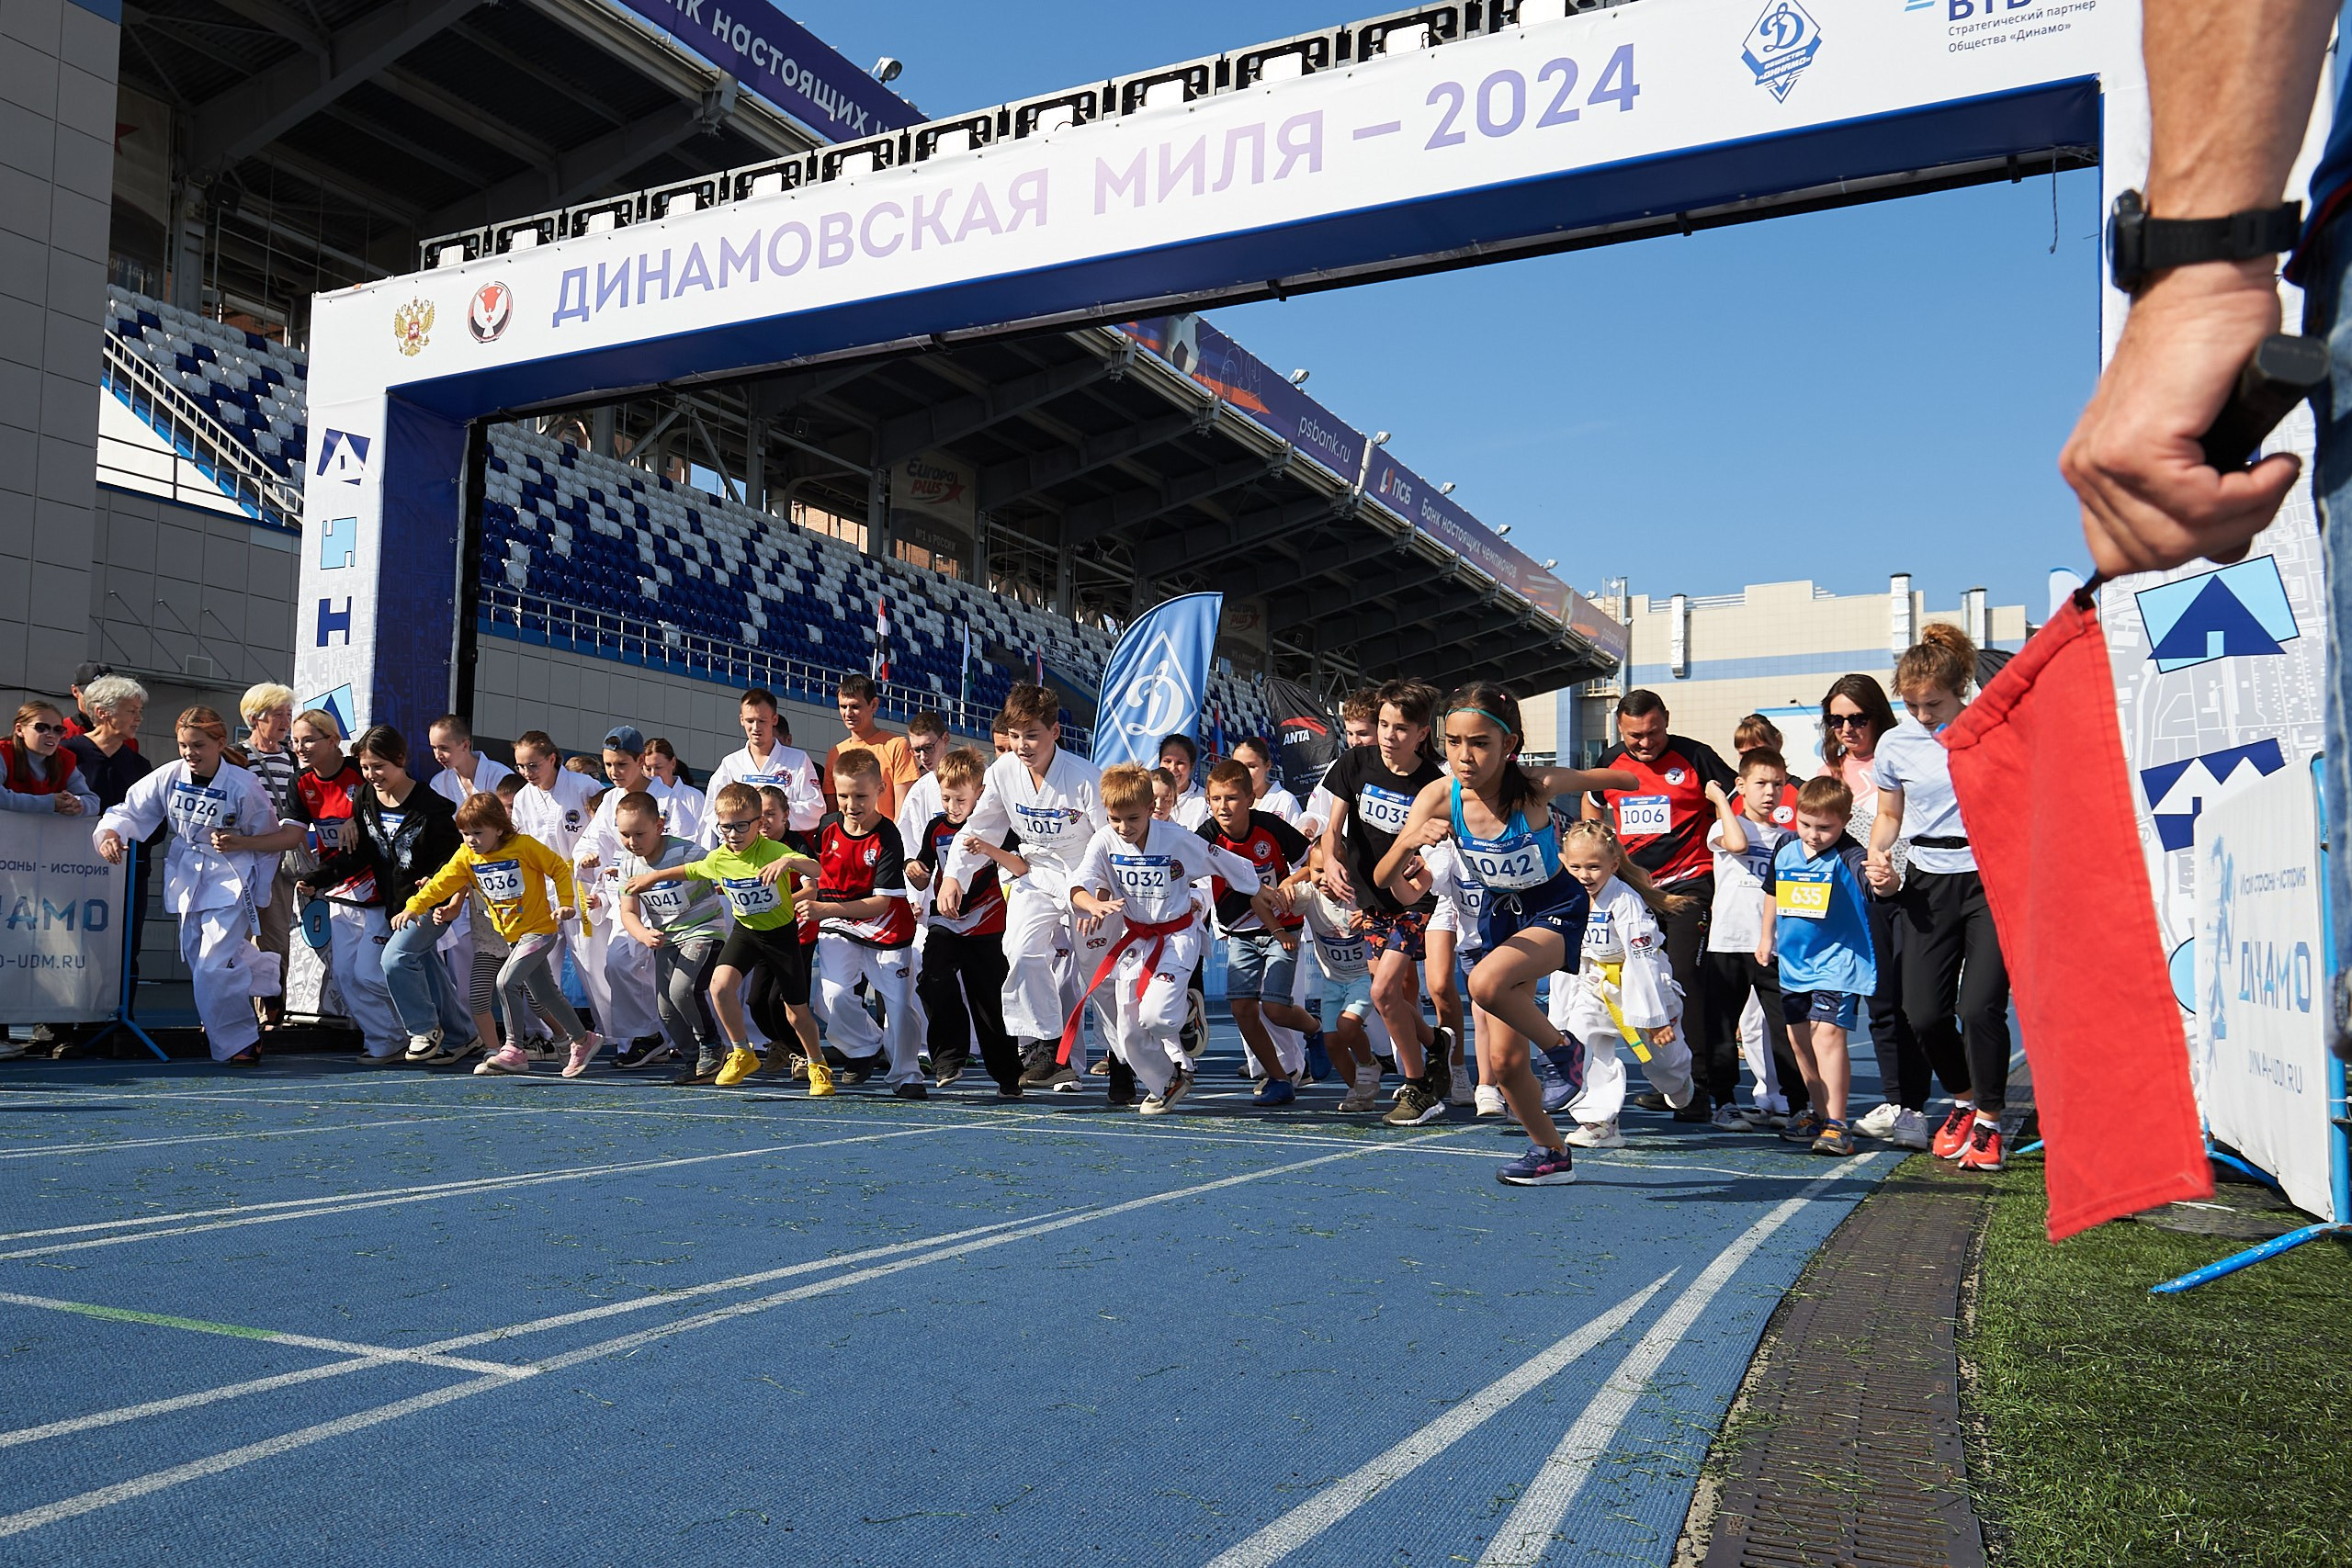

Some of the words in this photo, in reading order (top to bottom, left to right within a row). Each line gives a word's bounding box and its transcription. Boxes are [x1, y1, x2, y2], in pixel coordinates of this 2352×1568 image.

[1949, 7, 2043, 37] Стратегический
[2046, 1, 2097, 17] партнер
[1949, 35, 2007, 52] Общества
[2010, 23, 2071, 41] «Динамо»
[712, 8, 869, 136] настоящих
[552, 168, 1048, 328] ДИНАМОВСКАЯ
[1094, 109, 1323, 215] МИЛЯ
[1424, 43, 1641, 151] 2024
[1297, 415, 1351, 463] psbank.ru
[1392, 477, 1412, 505] ПСБ
[1421, 498, 1442, 526] Банк
[1441, 516, 1481, 554] настоящих
[1482, 544, 1517, 579] чемпионов
[1283, 729, 1310, 746] ANTA
[175, 795, 218, 817] 1026
[1024, 818, 1063, 834] 1017
[1624, 809, 1664, 824] 1006
[0, 860, 36, 872] раны
[51, 863, 109, 877] история
[1466, 854, 1534, 876] 1042
[477, 874, 518, 890] 1036
[1116, 870, 1164, 887] 1032
[643, 891, 682, 908] 1041
[730, 887, 774, 906] 1023
[1791, 886, 1822, 906] 635
[1323, 946, 1363, 962] 1015
